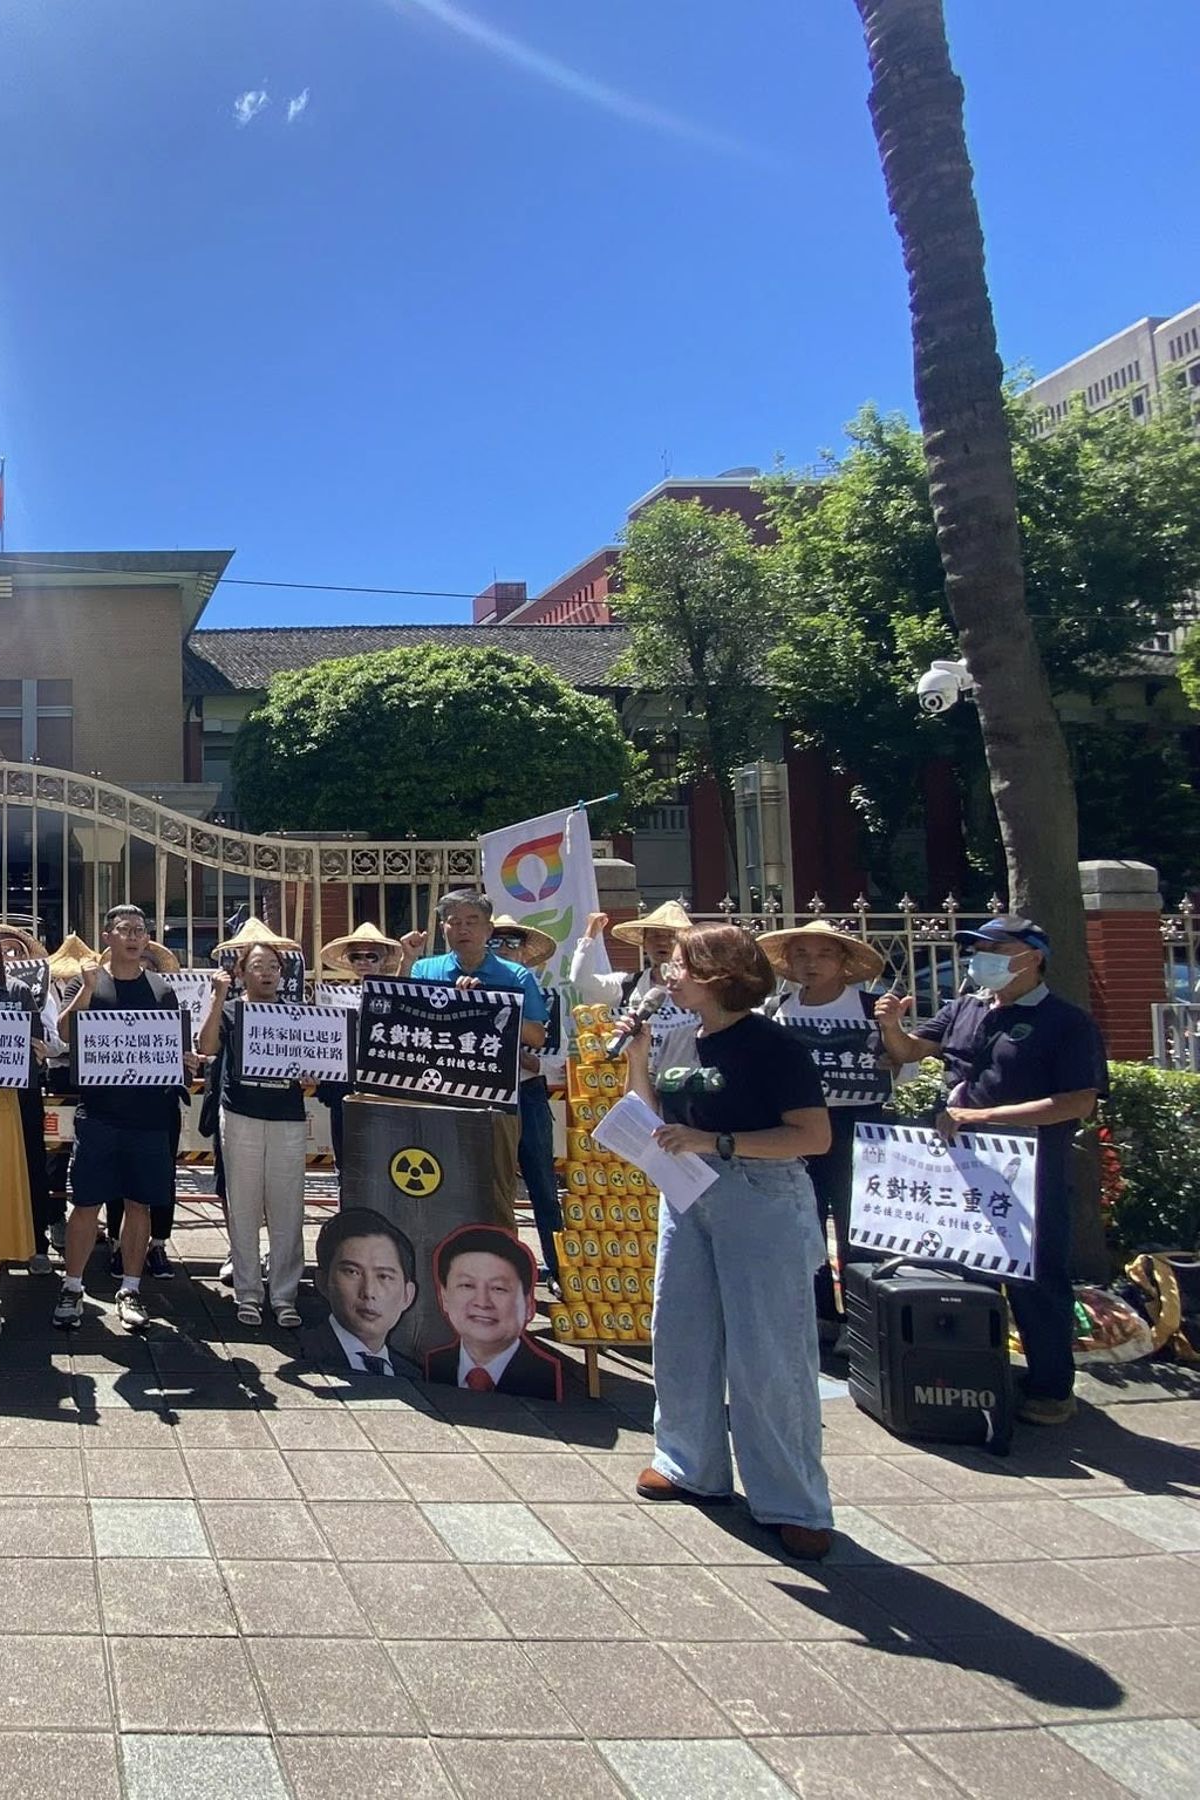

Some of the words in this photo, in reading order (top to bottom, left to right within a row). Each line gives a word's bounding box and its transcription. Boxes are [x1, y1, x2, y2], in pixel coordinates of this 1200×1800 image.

[248, 1026, 342, 1043] 非核家園已起步
[84, 1050, 178, 1064] 斷層就在核電站
[248, 1042, 343, 1060] 莫走回頭冤枉路
[914, 1385, 996, 1408] MIPRO
